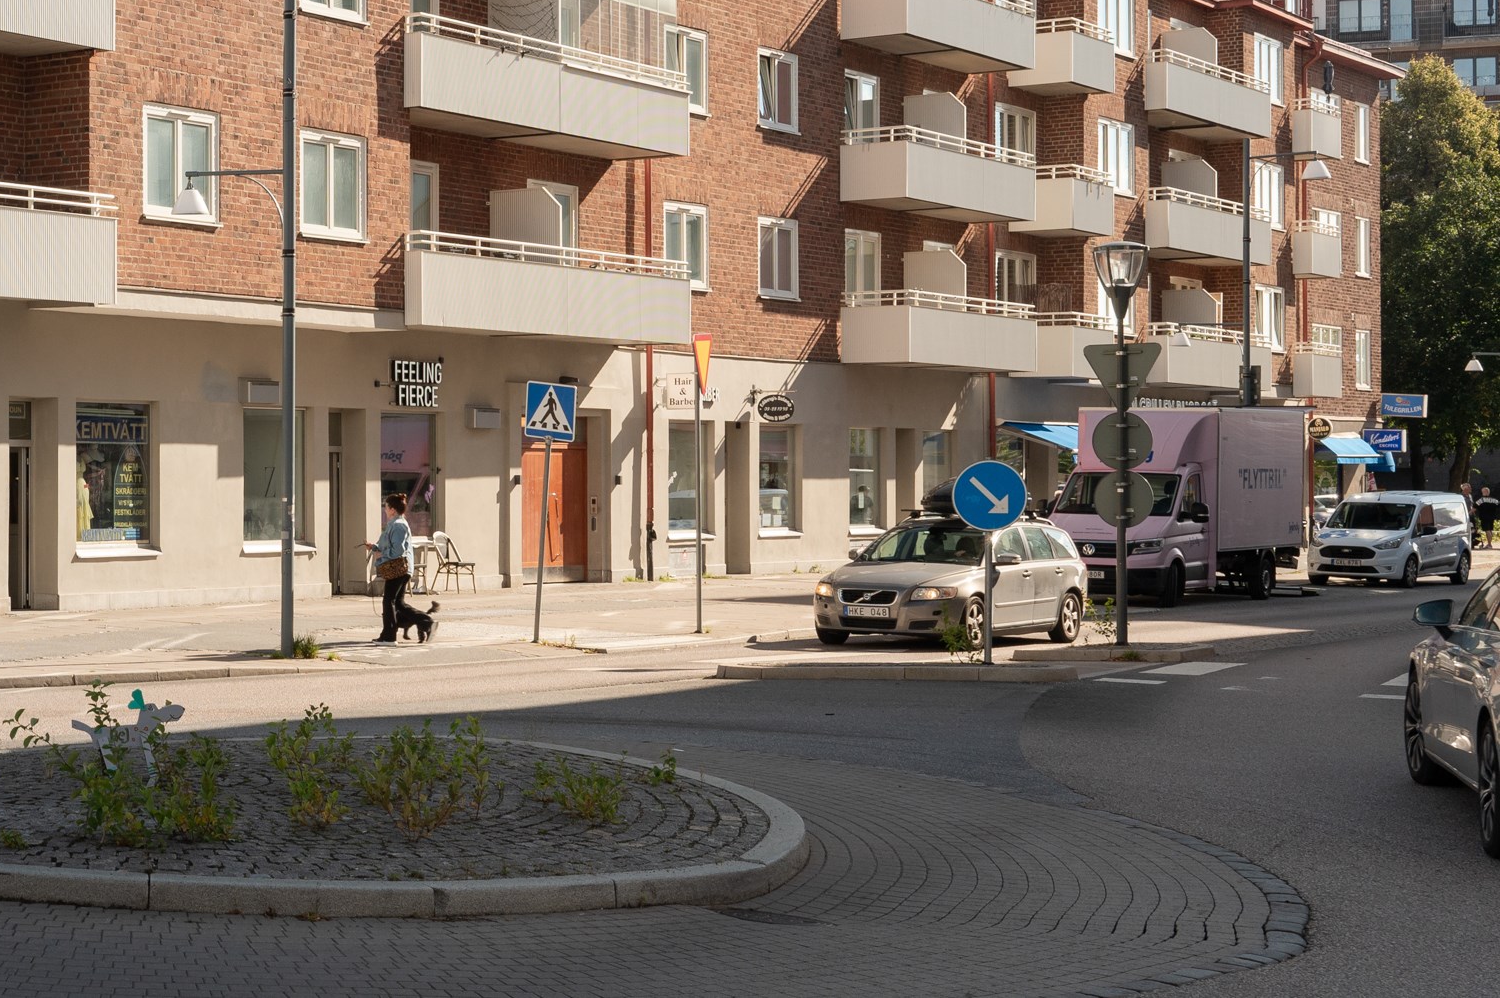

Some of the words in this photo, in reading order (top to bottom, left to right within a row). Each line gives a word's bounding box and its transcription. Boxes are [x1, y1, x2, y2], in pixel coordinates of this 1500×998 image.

[394, 360, 442, 384] FEELING
[674, 377, 693, 386] Hair
[398, 385, 439, 407] FIERCE
[679, 388, 687, 396] &
[669, 397, 697, 407] Barbe
[1384, 403, 1422, 414] TULEGRILLEN
[1369, 432, 1400, 445] Konditori
[120, 472, 143, 483] TVÄTT
[871, 608, 887, 616] 048
